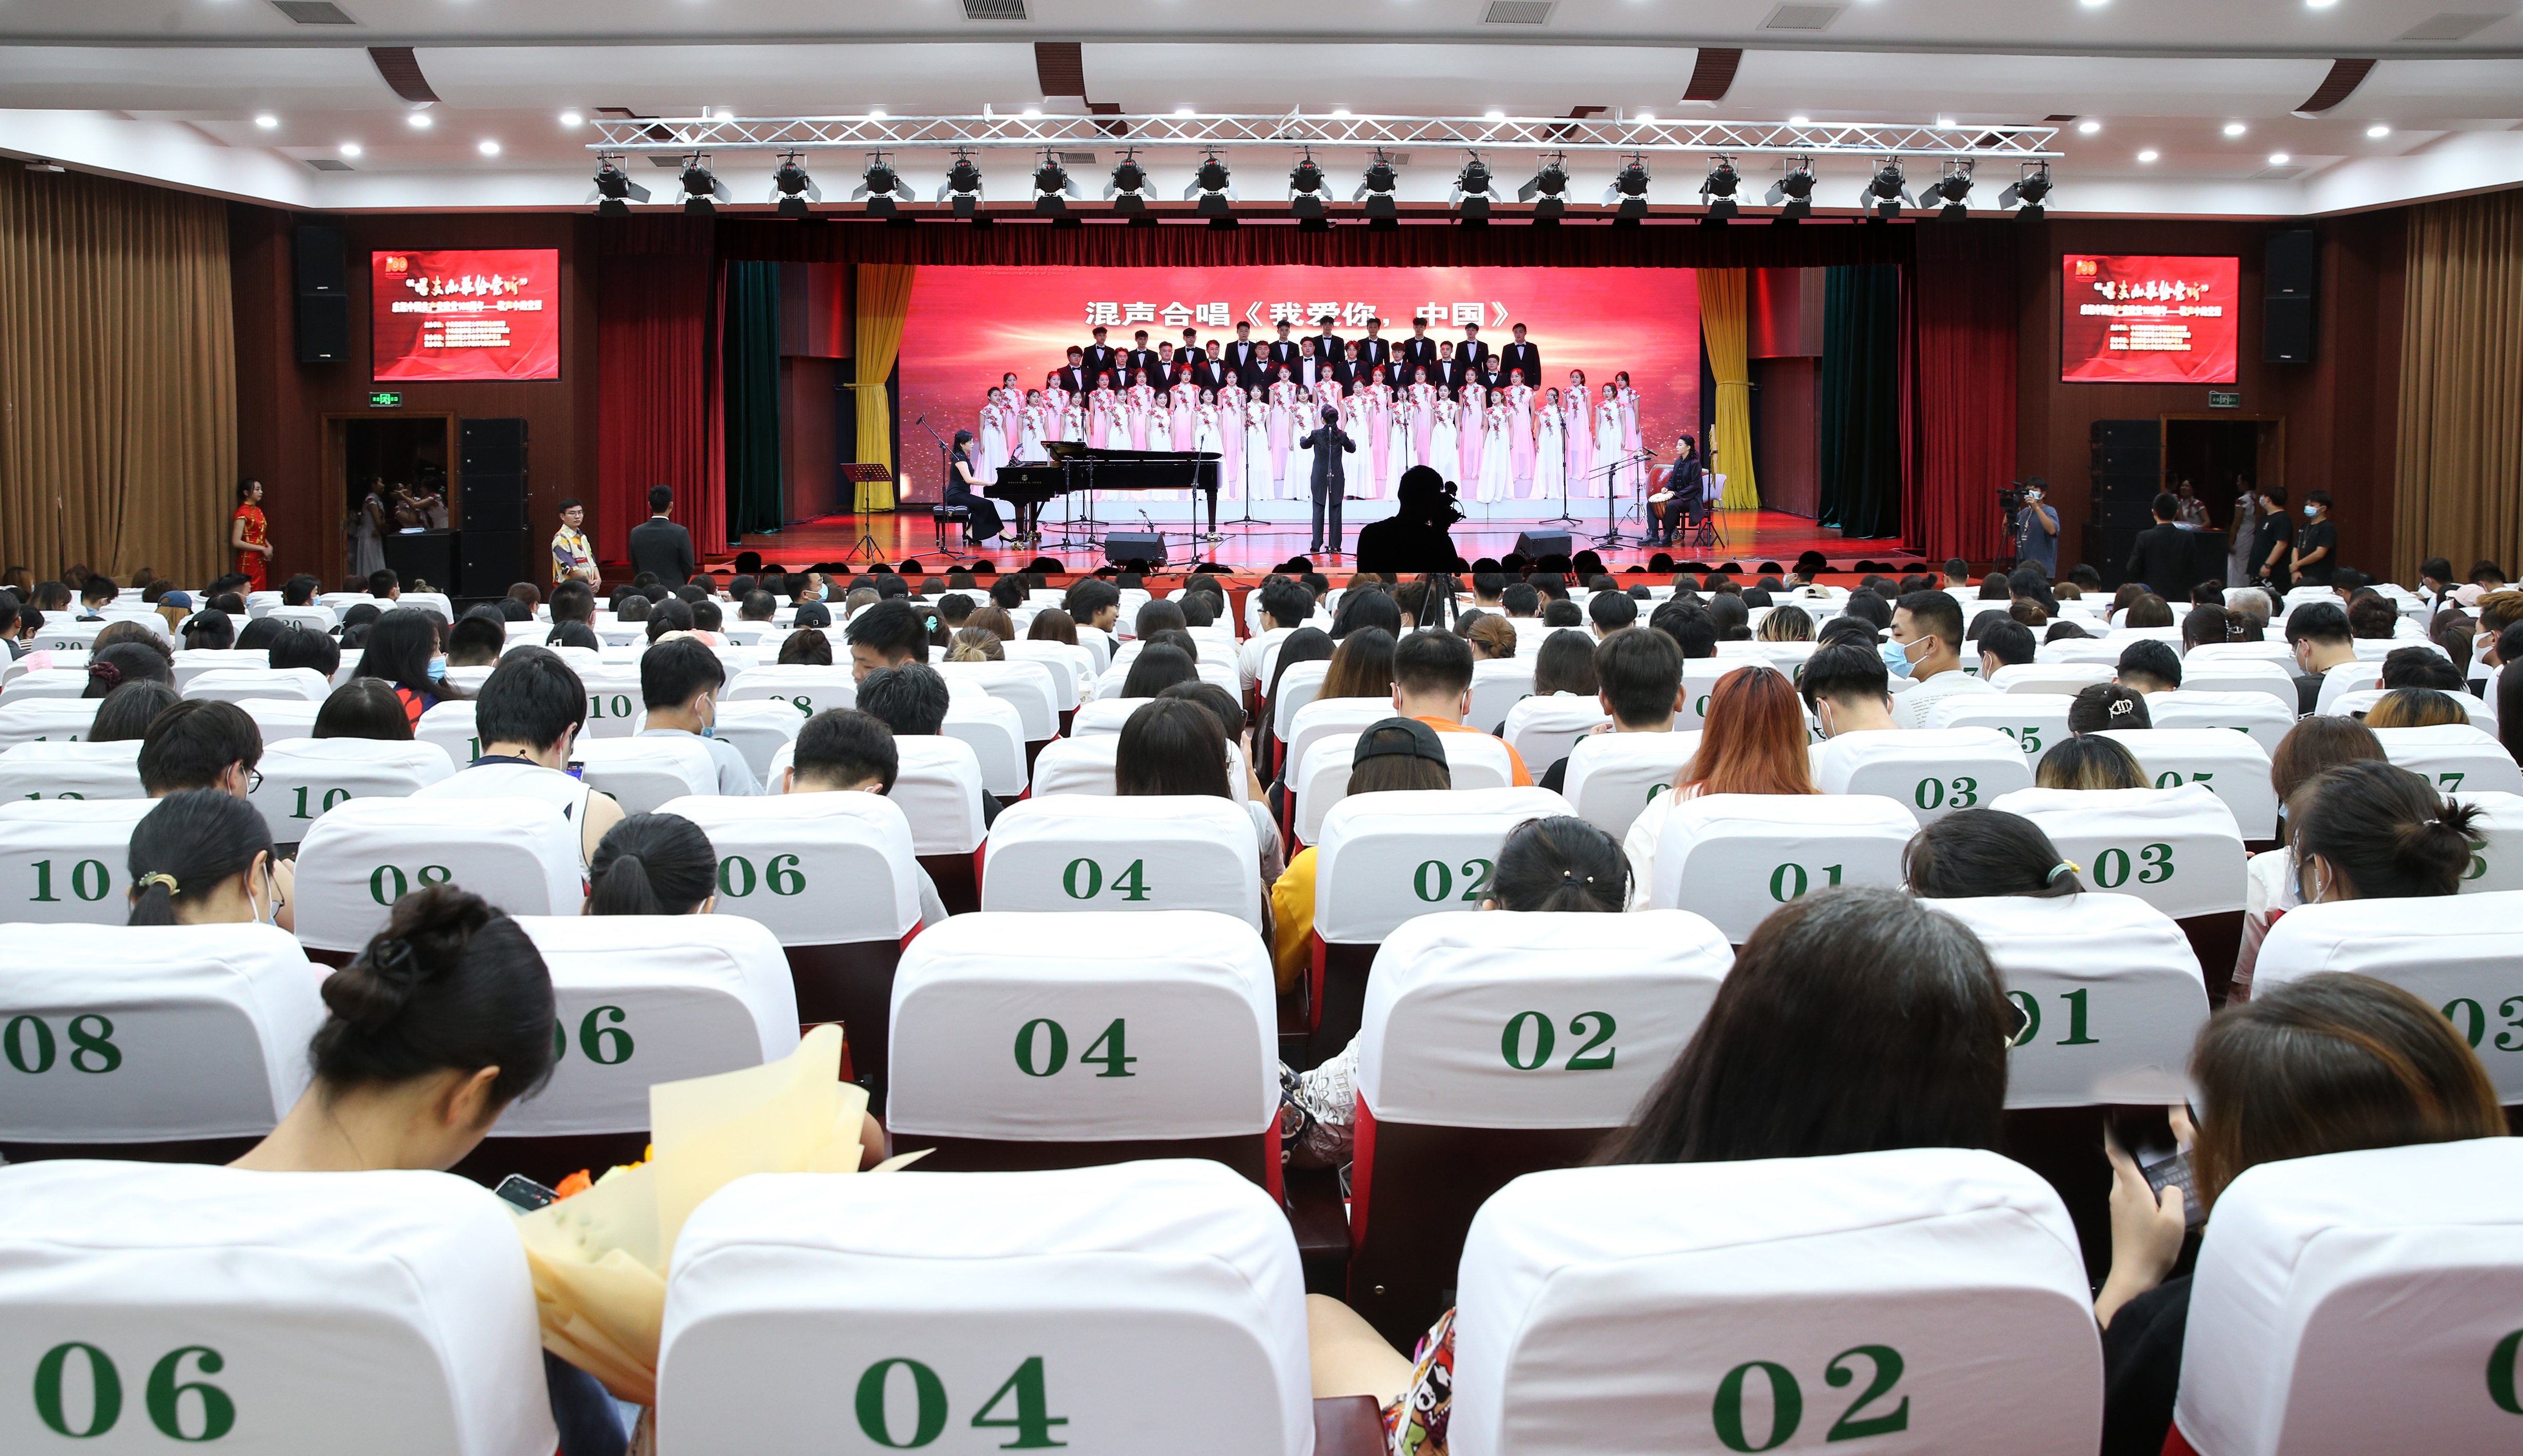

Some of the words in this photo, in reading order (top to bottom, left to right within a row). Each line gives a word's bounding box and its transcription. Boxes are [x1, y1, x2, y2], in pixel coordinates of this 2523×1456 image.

[589, 695, 632, 718] 10
[769, 695, 813, 718] 8
[1916, 776, 1978, 810] 03
[29, 859, 110, 902] 10
[717, 854, 806, 897] 06
[1062, 858, 1152, 901] 04
[1414, 858, 1497, 902] 02
[1770, 863, 1842, 902] 01
[2094, 843, 2175, 889] 03
[4, 1015, 121, 1073] 08
[555, 1005, 633, 1065] 6
[1014, 1018, 1137, 1077] 04
[1501, 1011, 1617, 1070] 02
[33, 1342, 235, 1442] 06
[854, 1356, 1069, 1449] 04
[1712, 1344, 1909, 1452] 02
